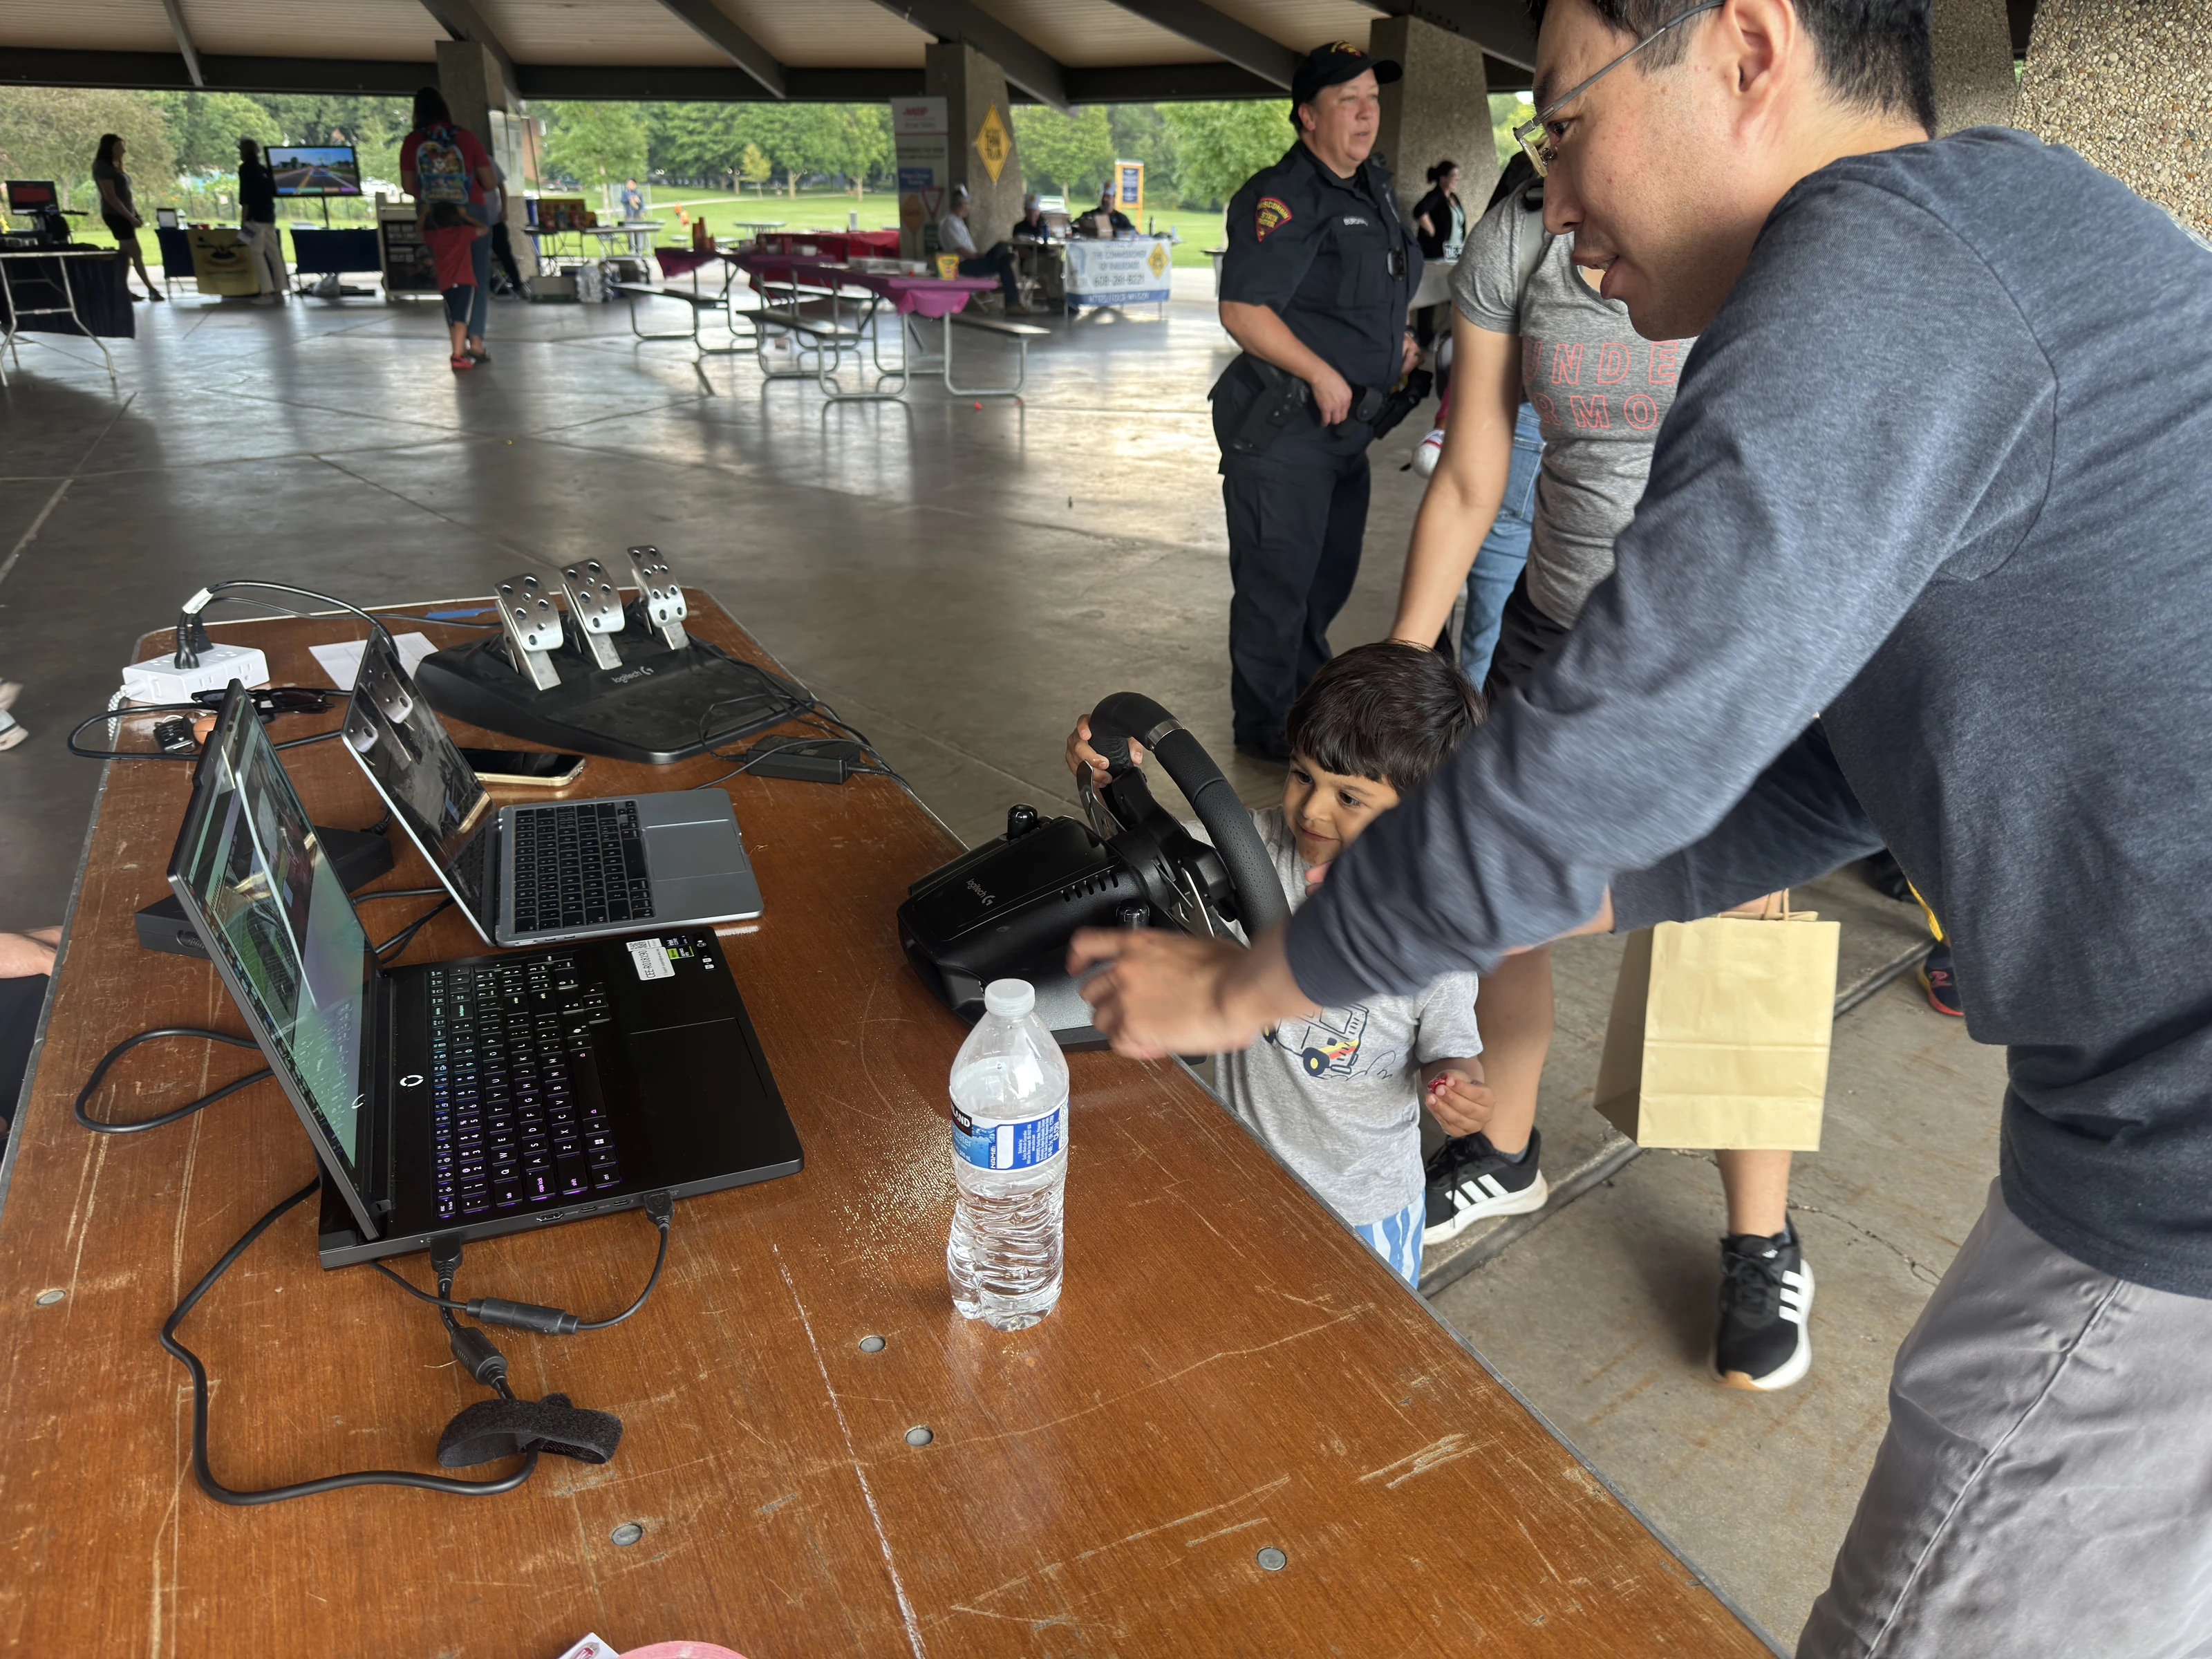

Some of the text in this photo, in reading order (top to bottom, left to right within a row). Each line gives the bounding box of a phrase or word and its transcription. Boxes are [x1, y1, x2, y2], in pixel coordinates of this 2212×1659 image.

[1257, 200, 1289, 219] WISCONSIN
[1261, 212, 1279, 223] STATE
[1525, 337, 1678, 384] UNDE
[1533, 393, 1658, 430] RMO
[611, 671, 643, 684] logitech
[966, 878, 987, 898] logitech
[638, 950, 656, 978] CEE-R018190
[955, 1132, 972, 1147] water
